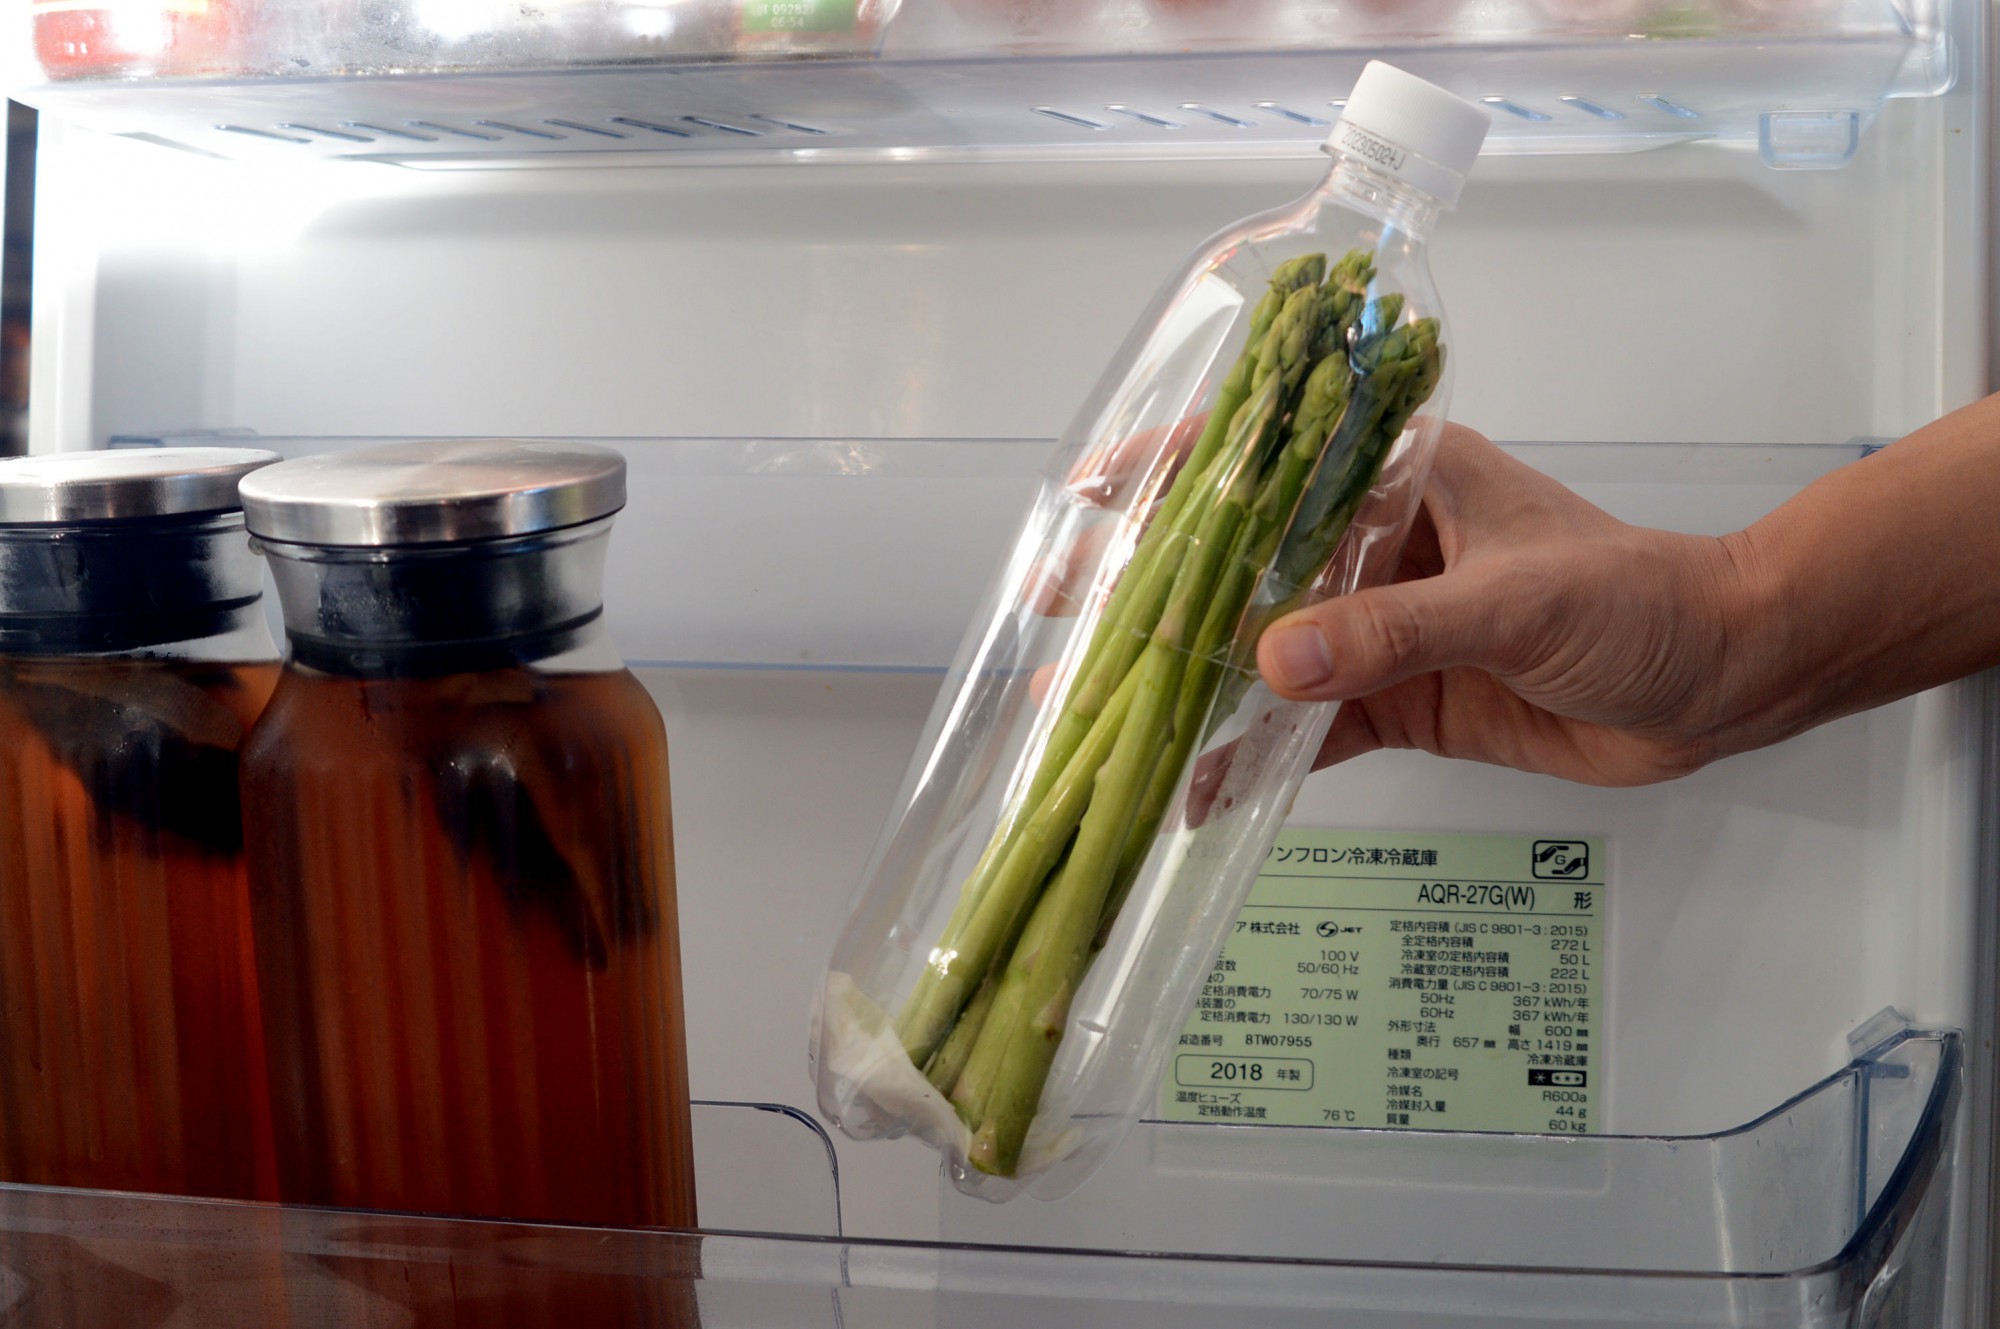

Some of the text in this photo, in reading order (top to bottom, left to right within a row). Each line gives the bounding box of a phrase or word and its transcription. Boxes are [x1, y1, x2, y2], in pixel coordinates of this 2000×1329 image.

[1266, 846, 1438, 866] ノンフロン冷凍冷蔵庫
[1417, 882, 1592, 911] AQR-27G(W) 形
[1391, 920, 1449, 933] 定格内容積
[1402, 935, 1590, 951] 全定格内容積 272 L
[1321, 950, 1359, 962] 100 V
[1402, 949, 1590, 965] 冷凍室の定格内容積 50 L
[1298, 961, 1340, 974] 50/60
[1343, 964, 1359, 975] Hz
[1402, 963, 1590, 980] 冷蔵室の定格内容積 222 L
[1389, 978, 1448, 990] 消費電力量
[1201, 985, 1358, 1000] 定格消費電力 70/75 W
[1421, 993, 1454, 1004] 50Hz
[1513, 996, 1540, 1007] 367
[1201, 1010, 1357, 1026] 定格消費電力 130/130 W
[1420, 1007, 1454, 1018] 60Hz
[1513, 1010, 1540, 1021] 367
[1388, 1020, 1436, 1033] 外形寸法
[1509, 1025, 1520, 1036] 幅
[1545, 1026, 1572, 1037] 600
[1179, 1034, 1312, 1047] 製造番号 8TW07955
[1417, 1035, 1440, 1047] 奥行
[1453, 1037, 1479, 1048] 657
[1508, 1039, 1530, 1050] 高さ
[1538, 1040, 1572, 1051] 1419
[1388, 1048, 1587, 1066] 種類 冷凍冷蔵庫
[1211, 1062, 1300, 1081] 2018 年製
[1387, 1067, 1458, 1080] 冷凍室の記号
[1176, 1091, 1241, 1105] 温度ヒューズ
[1387, 1085, 1587, 1103] 冷媒名 R600a
[1198, 1105, 1266, 1118] 定格動作温度
[1323, 1109, 1340, 1121] 76
[1387, 1099, 1586, 1118] 冷媒封入量 44 g
[1549, 1120, 1567, 1131] 60
[1571, 1121, 1586, 1133] kg
